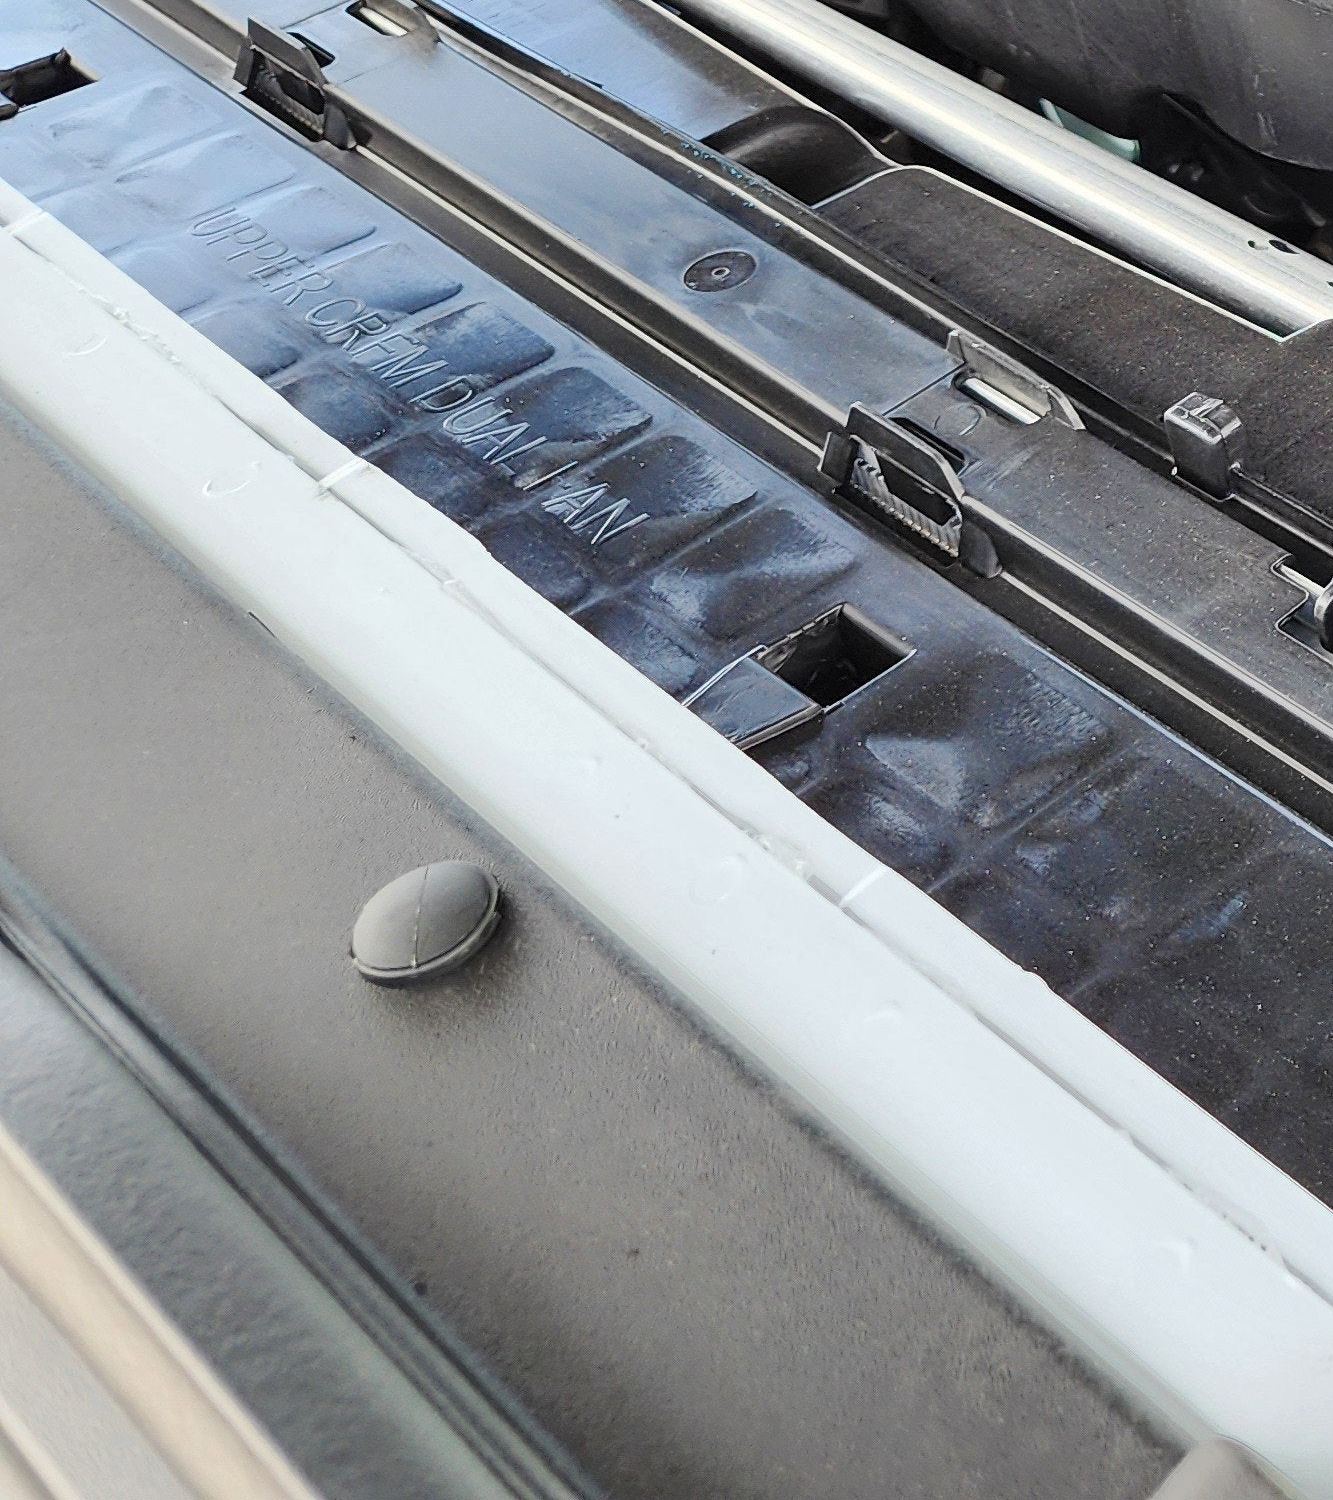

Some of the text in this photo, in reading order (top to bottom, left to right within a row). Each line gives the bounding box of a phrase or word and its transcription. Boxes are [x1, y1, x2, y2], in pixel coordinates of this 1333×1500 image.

[190, 206, 335, 307] UPPER
[304, 298, 450, 389] CRFM
[409, 375, 550, 477] DUAL
